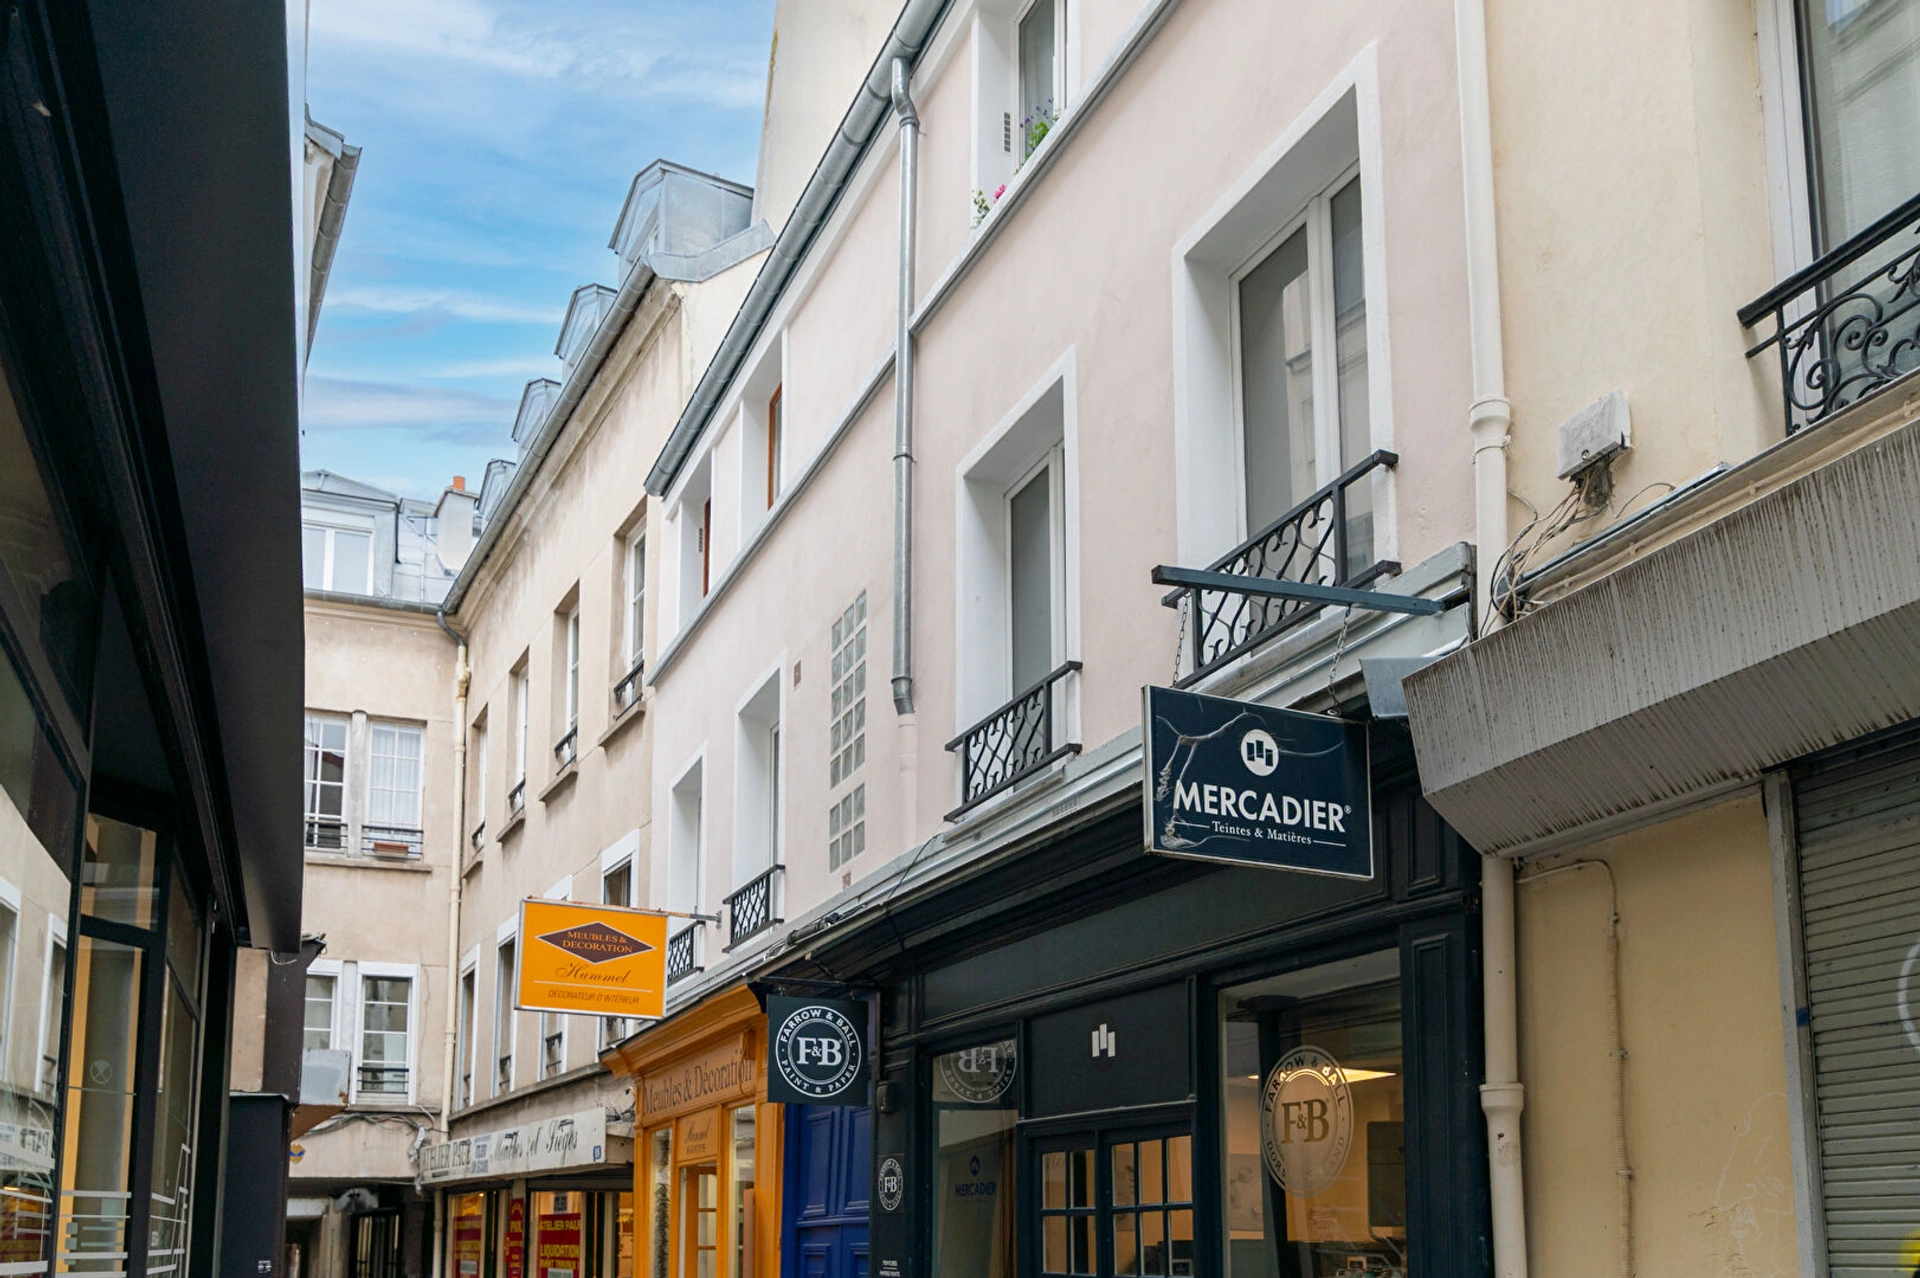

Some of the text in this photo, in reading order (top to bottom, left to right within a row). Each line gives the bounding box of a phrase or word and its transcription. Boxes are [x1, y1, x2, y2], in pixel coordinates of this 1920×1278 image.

[1212, 820, 1312, 845] Teintes & Matières
[562, 939, 633, 953] DECORATION
[555, 963, 632, 984] Hummel
[780, 1009, 857, 1047] FARROW & BALL
[796, 1036, 842, 1066] F&B
[781, 1060, 810, 1090] PAINT
[828, 1064, 855, 1091] PAPER
[1264, 1056, 1305, 1113] FARROW
[1321, 1065, 1346, 1108] BALL
[644, 1076, 682, 1114] Meubles
[1281, 1098, 1330, 1144] F&B
[955, 1181, 996, 1196] MERCADIER
